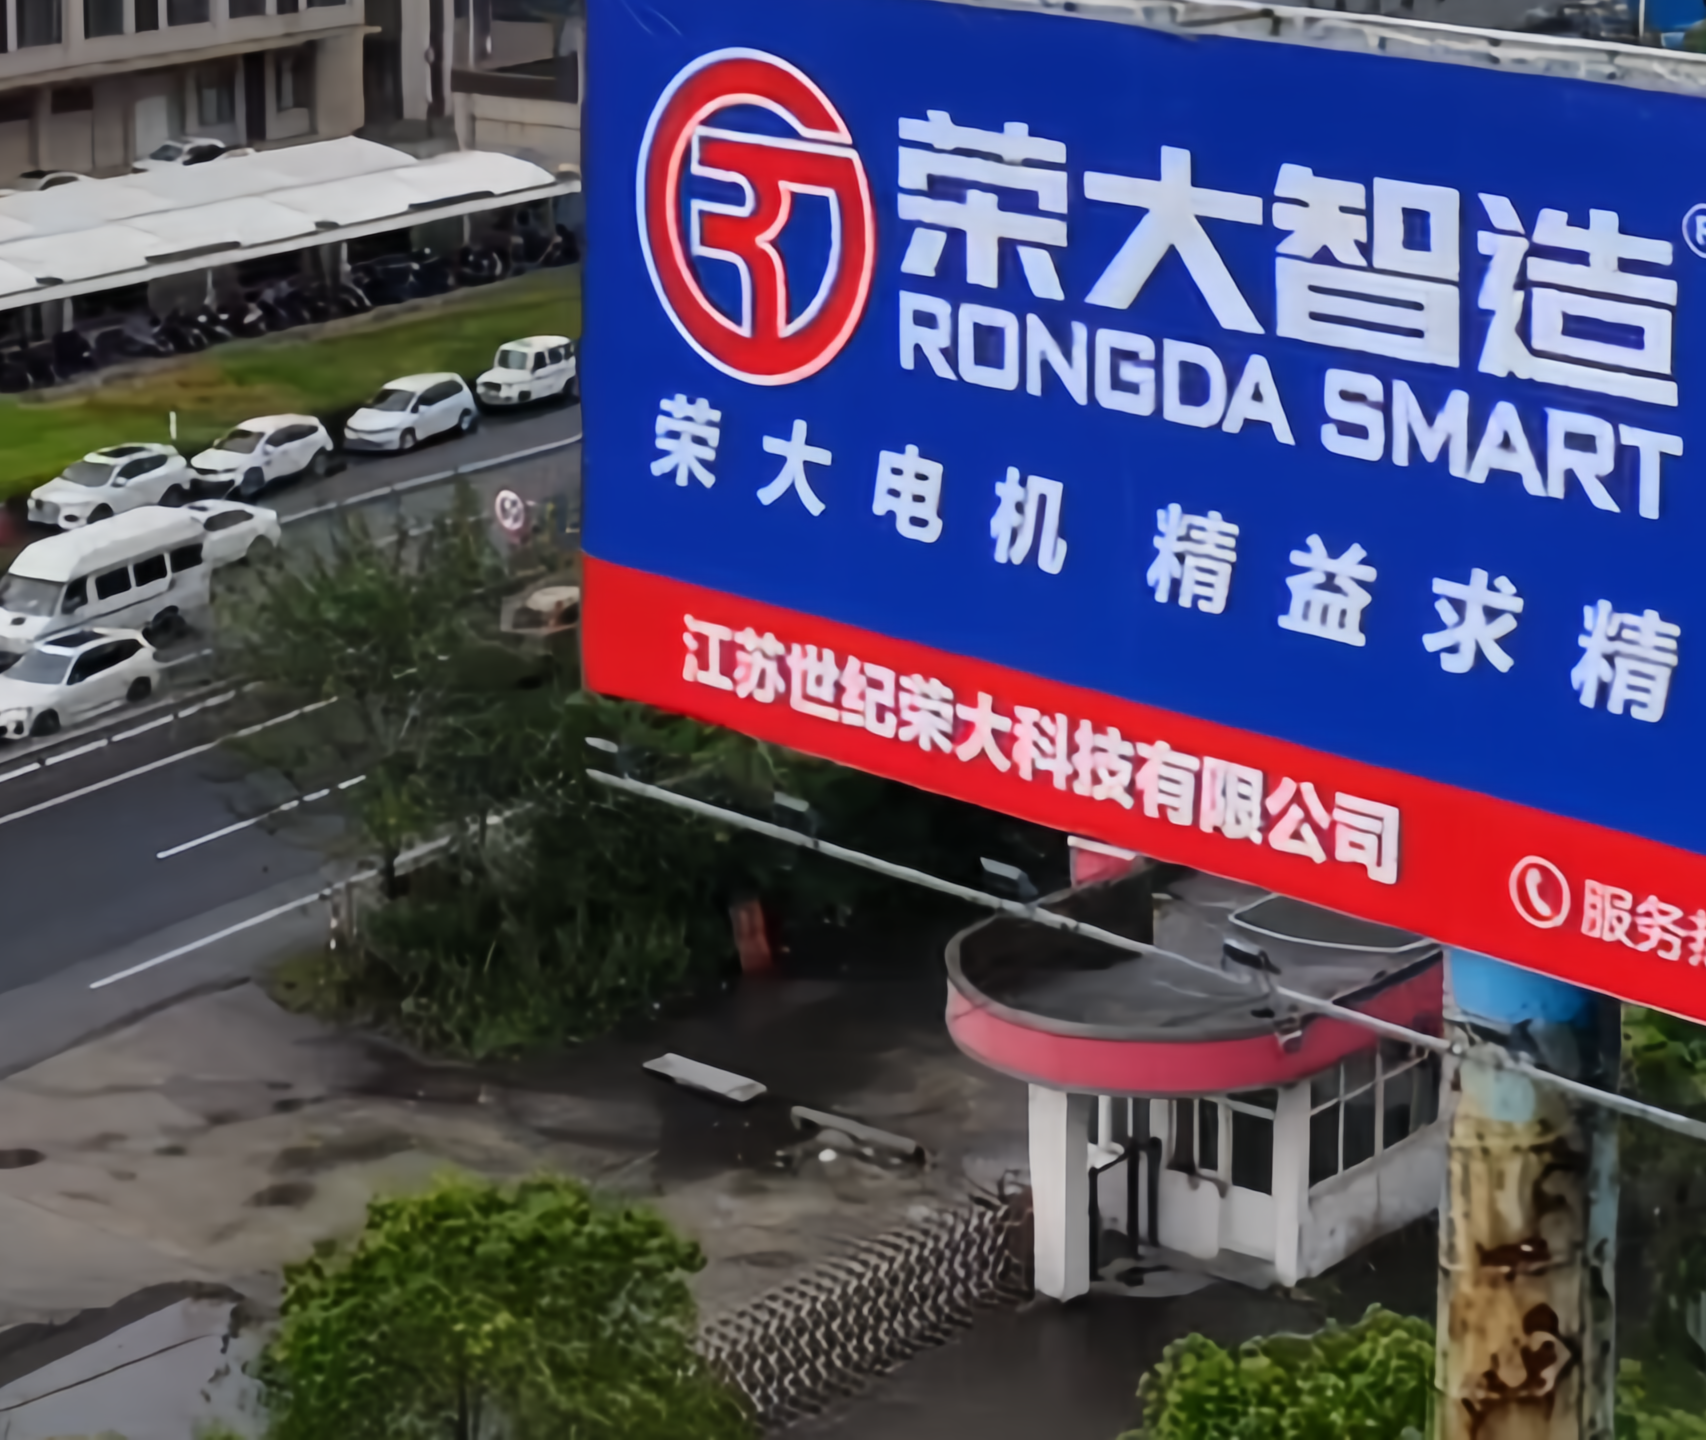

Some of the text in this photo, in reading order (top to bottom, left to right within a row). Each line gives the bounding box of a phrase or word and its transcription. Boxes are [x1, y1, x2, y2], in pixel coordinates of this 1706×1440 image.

[898, 109, 1681, 408] 荣大智造
[899, 290, 1683, 521] RONGDA SMART
[650, 394, 1681, 723] 荣大电机 精益求精
[683, 614, 1400, 884] 江苏世纪荣大科技有限公司
